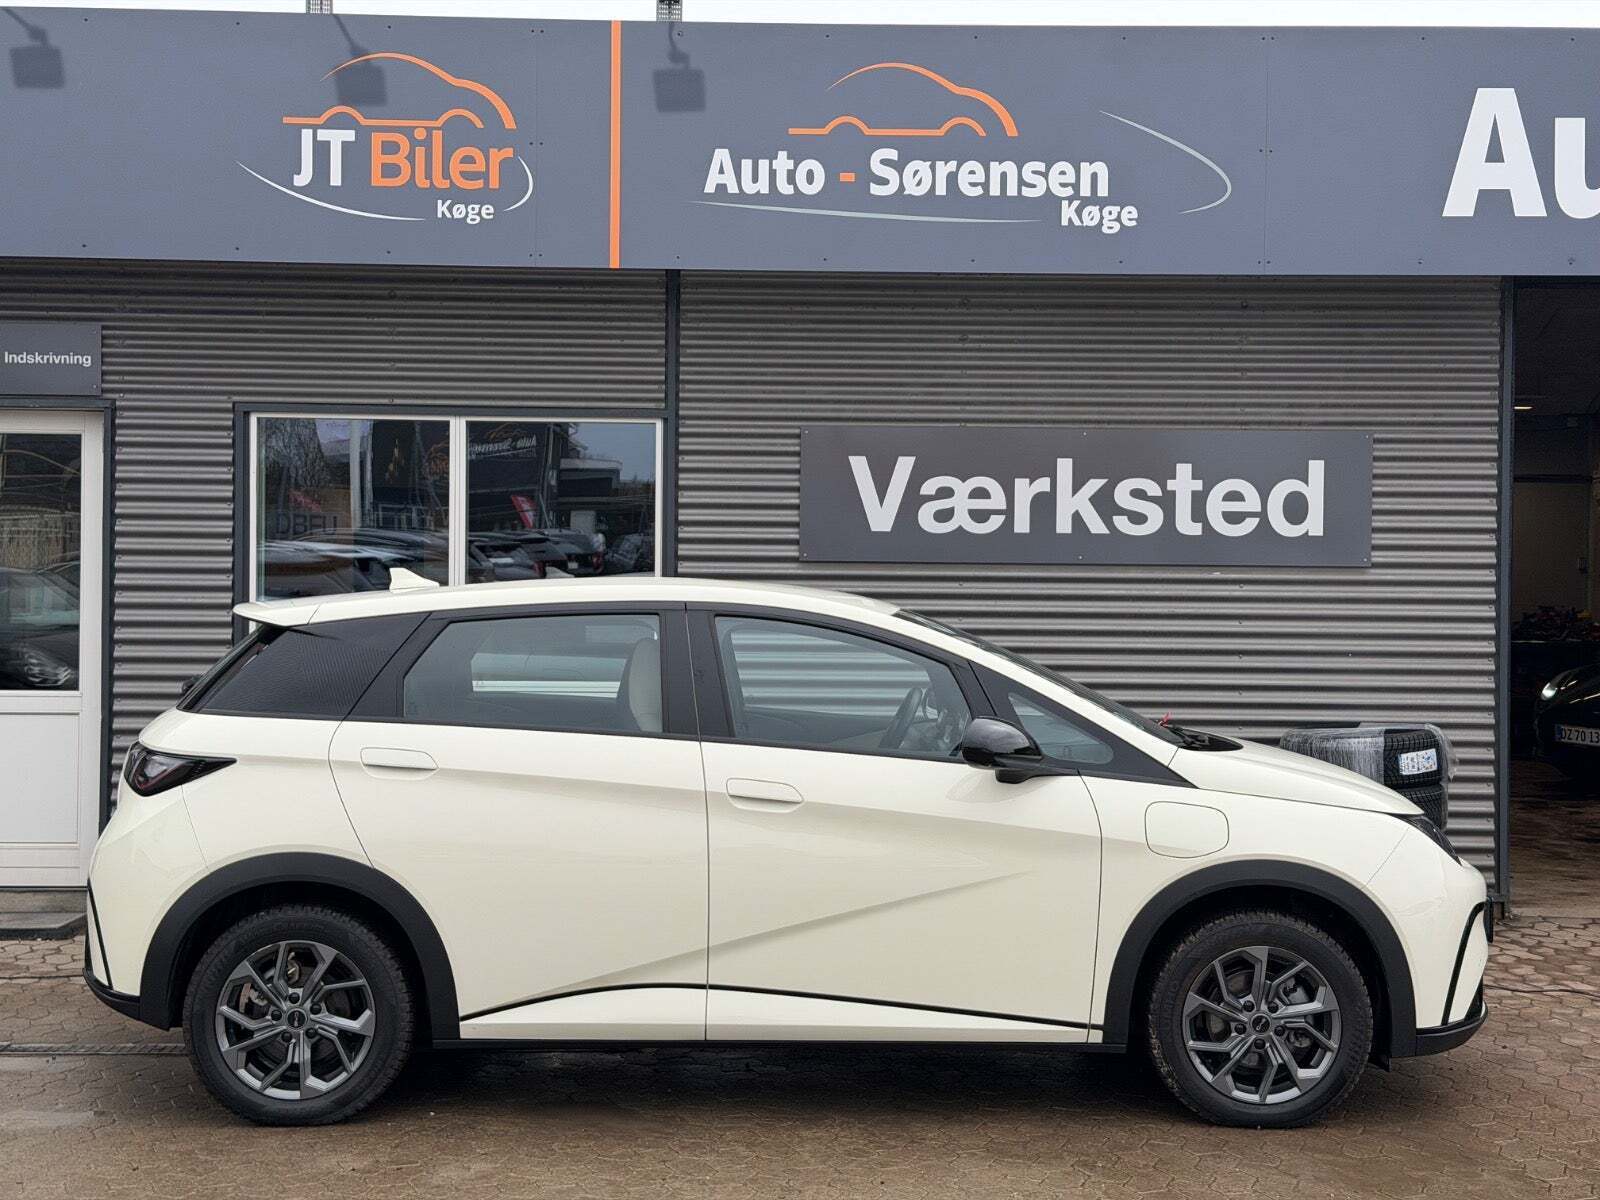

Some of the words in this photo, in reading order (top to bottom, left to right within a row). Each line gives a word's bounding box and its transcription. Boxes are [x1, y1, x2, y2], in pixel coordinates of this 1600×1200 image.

[294, 128, 355, 186] JT
[371, 127, 513, 189] Biler
[704, 148, 825, 195] Auto
[869, 148, 1109, 198] Sørensen
[1442, 88, 1600, 219] Au
[437, 199, 494, 224] Køge
[1061, 200, 1138, 234] Køge
[4, 351, 92, 367] Indskrivning
[848, 455, 1325, 537] Værksted
